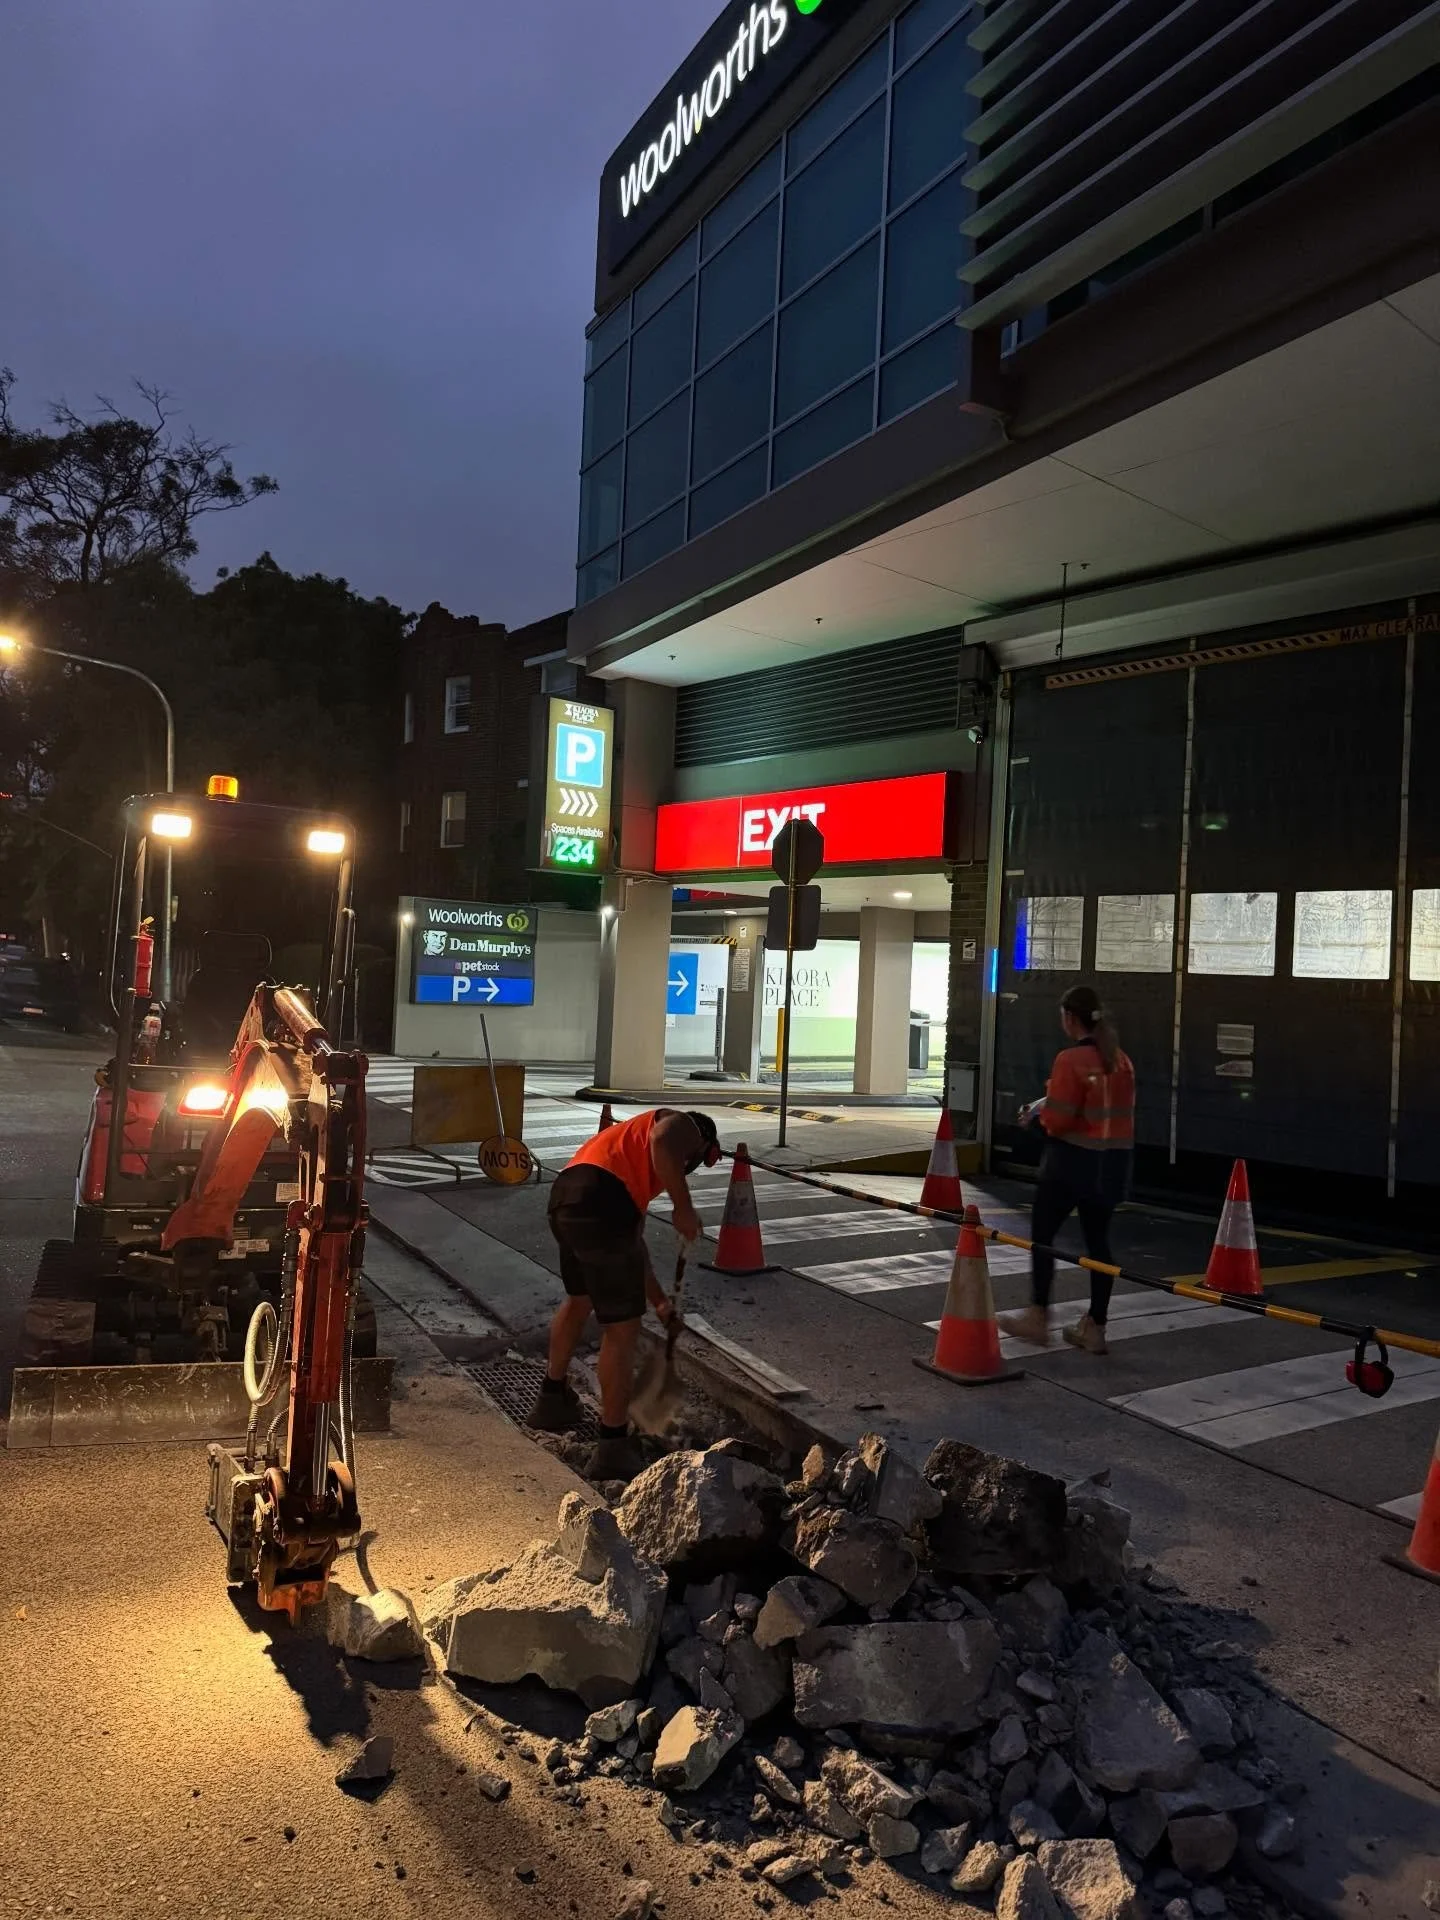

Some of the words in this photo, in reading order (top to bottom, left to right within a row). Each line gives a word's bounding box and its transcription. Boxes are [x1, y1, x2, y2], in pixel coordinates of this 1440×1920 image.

[1340, 625, 1370, 642] MAX
[566, 732, 596, 777] P
[551, 822, 576, 835] Spaces
[576, 825, 604, 838] Available
[555, 836, 595, 865] 234
[766, 967, 830, 987] KIORA
[452, 975, 471, 1002] P
[483, 1150, 530, 1169] SLOW
